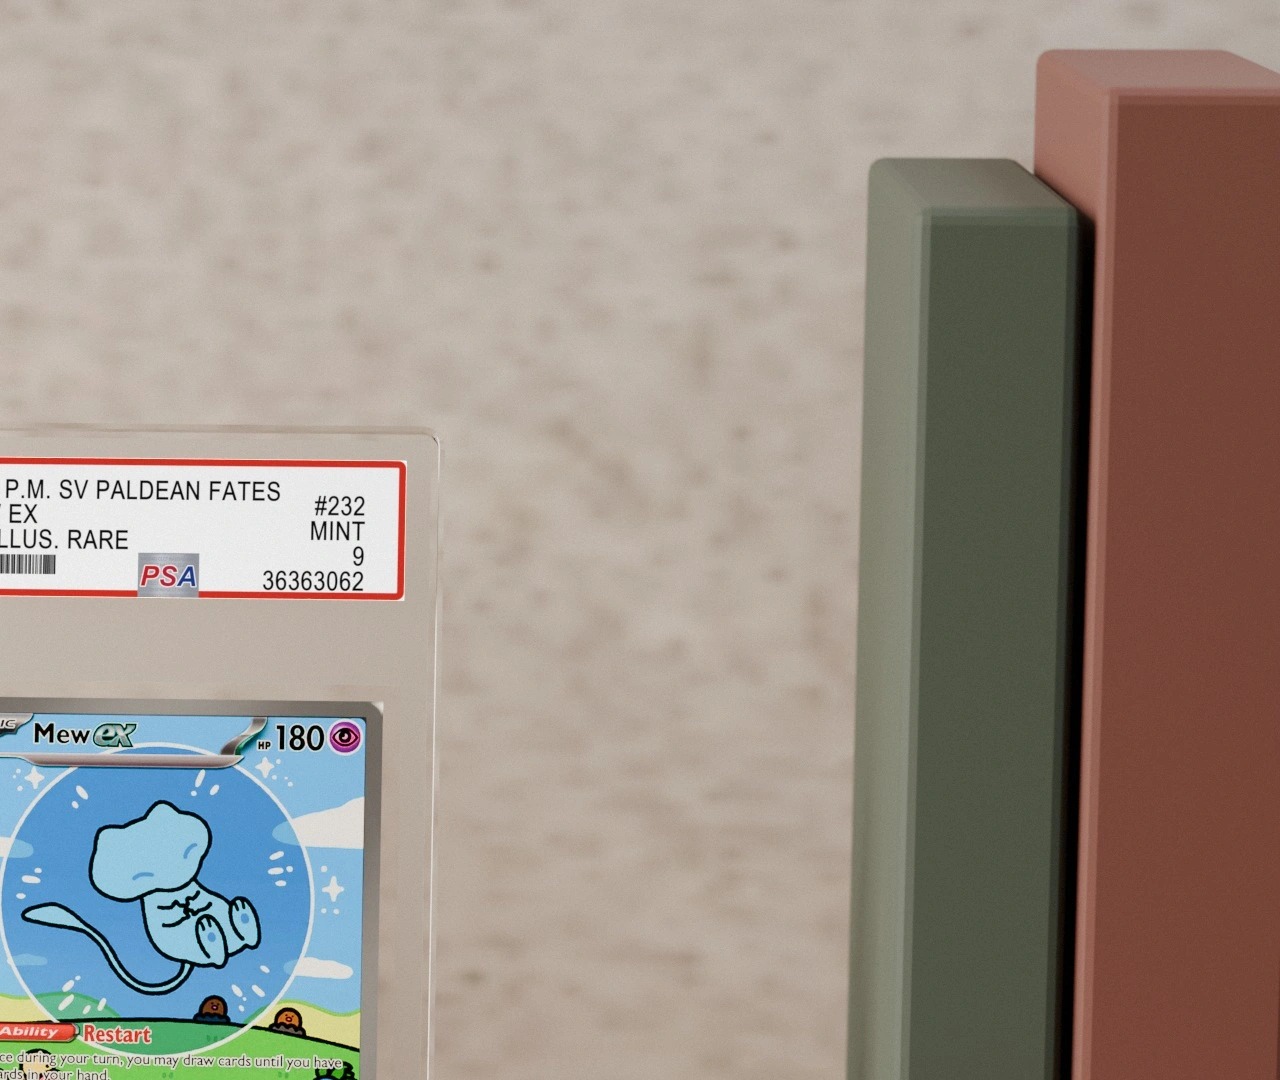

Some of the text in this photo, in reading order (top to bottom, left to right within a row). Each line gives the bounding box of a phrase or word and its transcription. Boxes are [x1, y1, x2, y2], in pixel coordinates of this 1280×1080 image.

[6, 479, 49, 498] P.M.
[60, 480, 88, 499] SV
[97, 480, 199, 500] PALDEAN
[210, 481, 280, 501] FATES
[10, 504, 37, 523] EX
[315, 496, 364, 516] #232
[69, 530, 128, 549] RARE
[311, 521, 365, 540] MINT
[353, 547, 363, 566] 9
[139, 564, 197, 588] PSA
[263, 571, 363, 591] 36363062
[34, 723, 91, 744] Mew
[256, 724, 325, 752] HP 180
[83, 1024, 152, 1044] Restart
